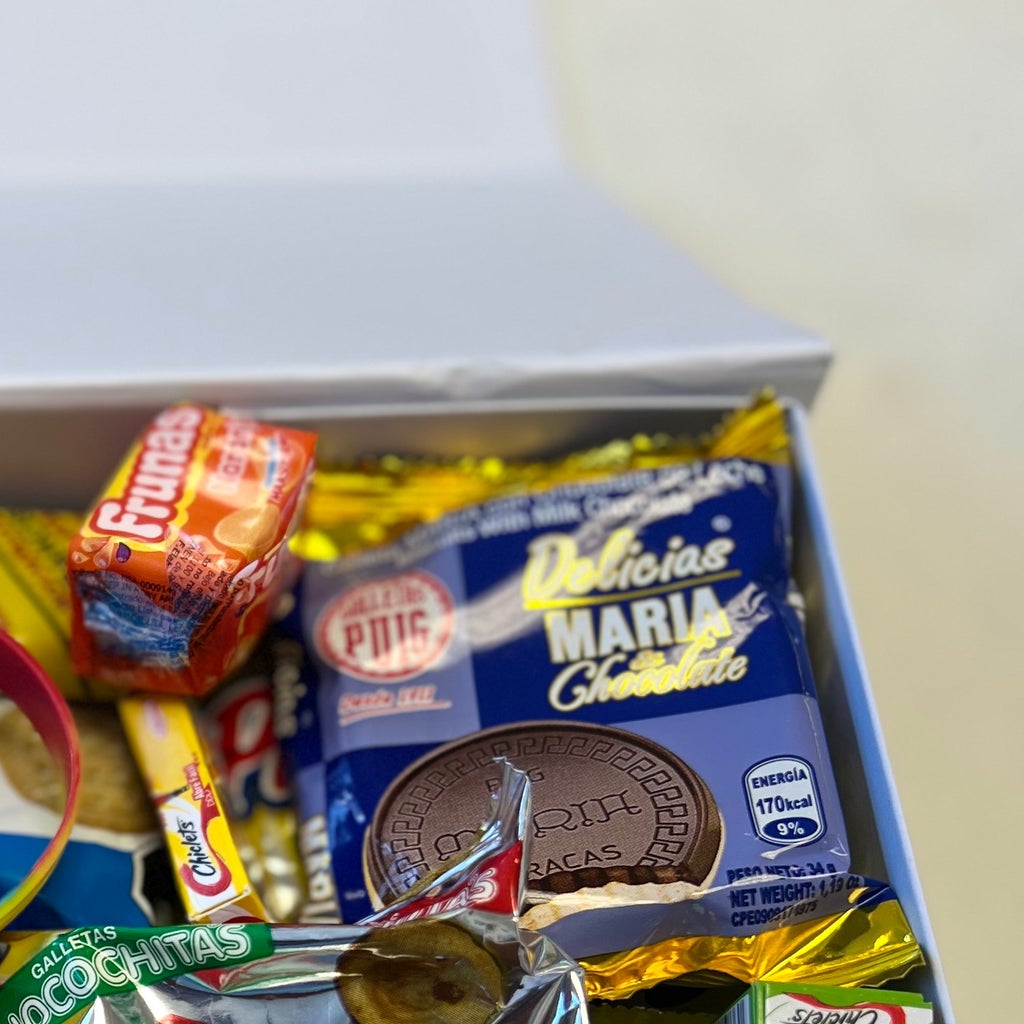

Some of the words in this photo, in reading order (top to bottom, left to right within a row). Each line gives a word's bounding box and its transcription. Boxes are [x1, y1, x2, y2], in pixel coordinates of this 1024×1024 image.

[522, 527, 736, 600] Delicias
[548, 636, 750, 712] Chocolate
[750, 766, 809, 789] ENERGÍA
[756, 794, 813, 816] 170kcal
[177, 816, 217, 877] Chiclets
[776, 820, 806, 837] 9%
[528, 844, 623, 881] RACAS
[730, 886, 757, 908] NET
[760, 881, 816, 904] WEIGHT:
[31, 926, 117, 979] GALLETAS
